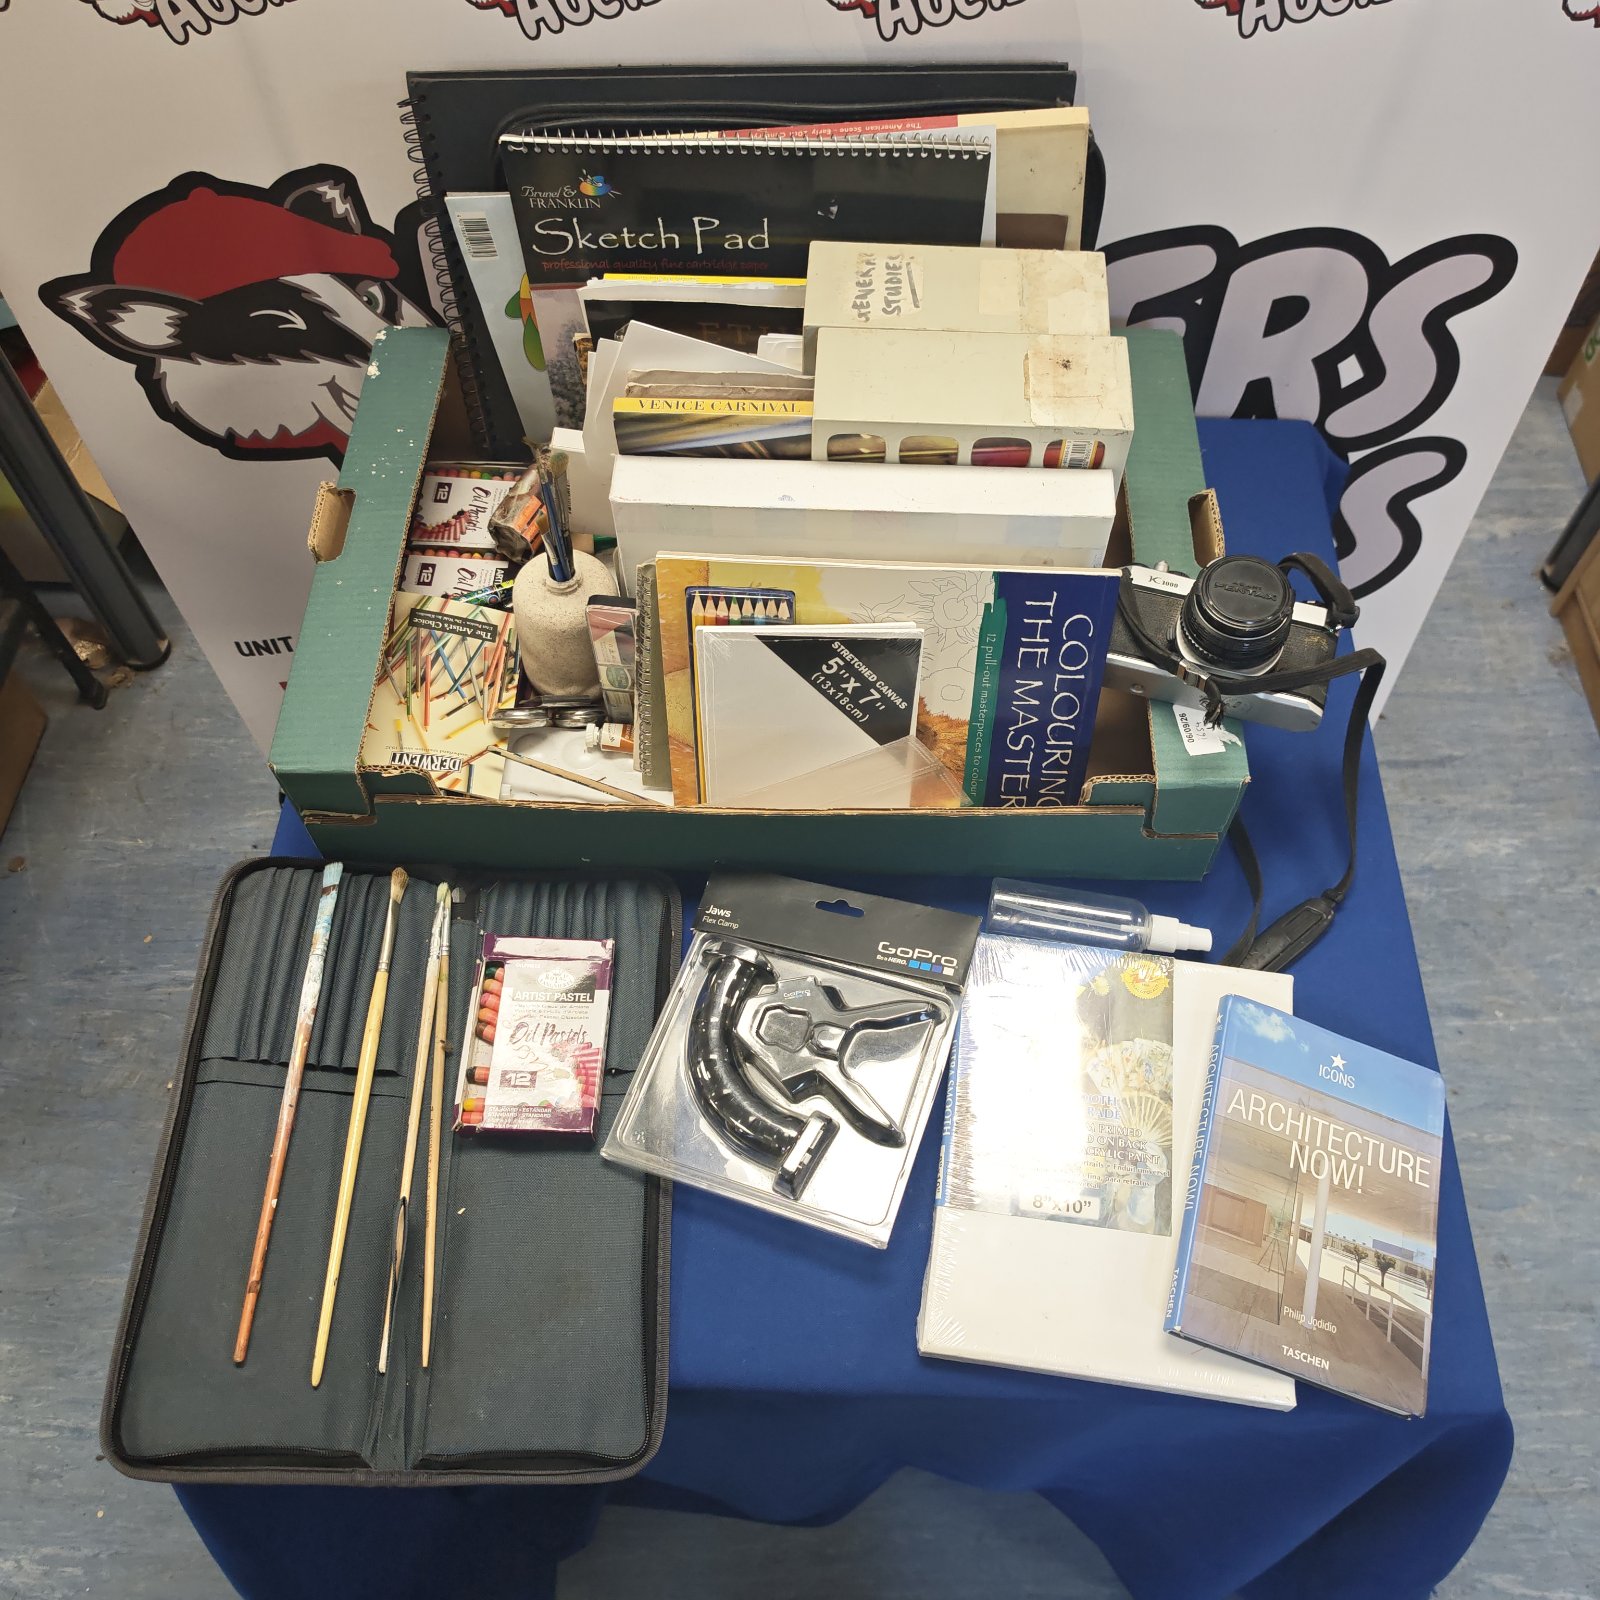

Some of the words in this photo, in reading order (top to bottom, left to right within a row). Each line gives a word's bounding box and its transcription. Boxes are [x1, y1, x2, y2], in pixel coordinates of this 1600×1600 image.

[866, 123, 902, 131] American
[520, 185, 560, 198] Brunel
[562, 185, 577, 198] &
[529, 198, 601, 209] FRANKLIN
[532, 216, 680, 256] Sketch
[692, 215, 770, 254] Pad
[541, 259, 609, 272] professional
[613, 259, 658, 272] quality
[661, 259, 684, 270] fine
[638, 399, 705, 411] VENICE
[711, 400, 801, 413] CARNIVAL
[436, 484, 449, 501] 12
[471, 486, 491, 504] Oil
[419, 566, 433, 583] 12
[456, 567, 477, 586] Oil
[1213, 582, 1278, 602] PENTAX
[412, 617, 442, 629] Choice
[444, 623, 474, 635] Artist's
[1017, 591, 1058, 669] THE
[476, 630, 493, 640] The
[986, 632, 997, 642] 12
[234, 636, 294, 658] UNIT
[980, 645, 997, 685] pull-out
[831, 641, 878, 682] STRETCHED
[875, 681, 908, 709] CANVAS
[811, 672, 870, 723] (13x18cm)
[971, 688, 992, 753] masterpieces
[391, 752, 462, 772] DERWENT
[973, 755, 981, 766] to
[970, 767, 984, 796] colour
[705, 904, 731, 918] Jaws
[702, 916, 717, 925] Flex
[717, 918, 739, 930] Clamp
[877, 941, 958, 967] GoPro
[514, 991, 553, 1001] ARTIST
[554, 992, 593, 1002] PASTEL
[510, 1023, 538, 1044] Oil
[542, 1022, 588, 1046] Pastels
[506, 1072, 531, 1086] 12
[1319, 1065, 1355, 1089] ICONS
[942, 1077, 955, 1136] SMOOTH
[1098, 1123, 1143, 1138] PRIMED
[1227, 1089, 1431, 1189] ARCHITECTURE
[1097, 1135, 1115, 1146] ON
[1118, 1138, 1147, 1150] BACK
[1128, 1151, 1161, 1165] PAINT
[1289, 1140, 1364, 1194] NOW!
[1166, 1267, 1181, 1319] TASCHEN
[1283, 1305, 1306, 1323] Philip
[1307, 1315, 1337, 1334] Jodidio
[1281, 1345, 1330, 1371] TASCHEN
